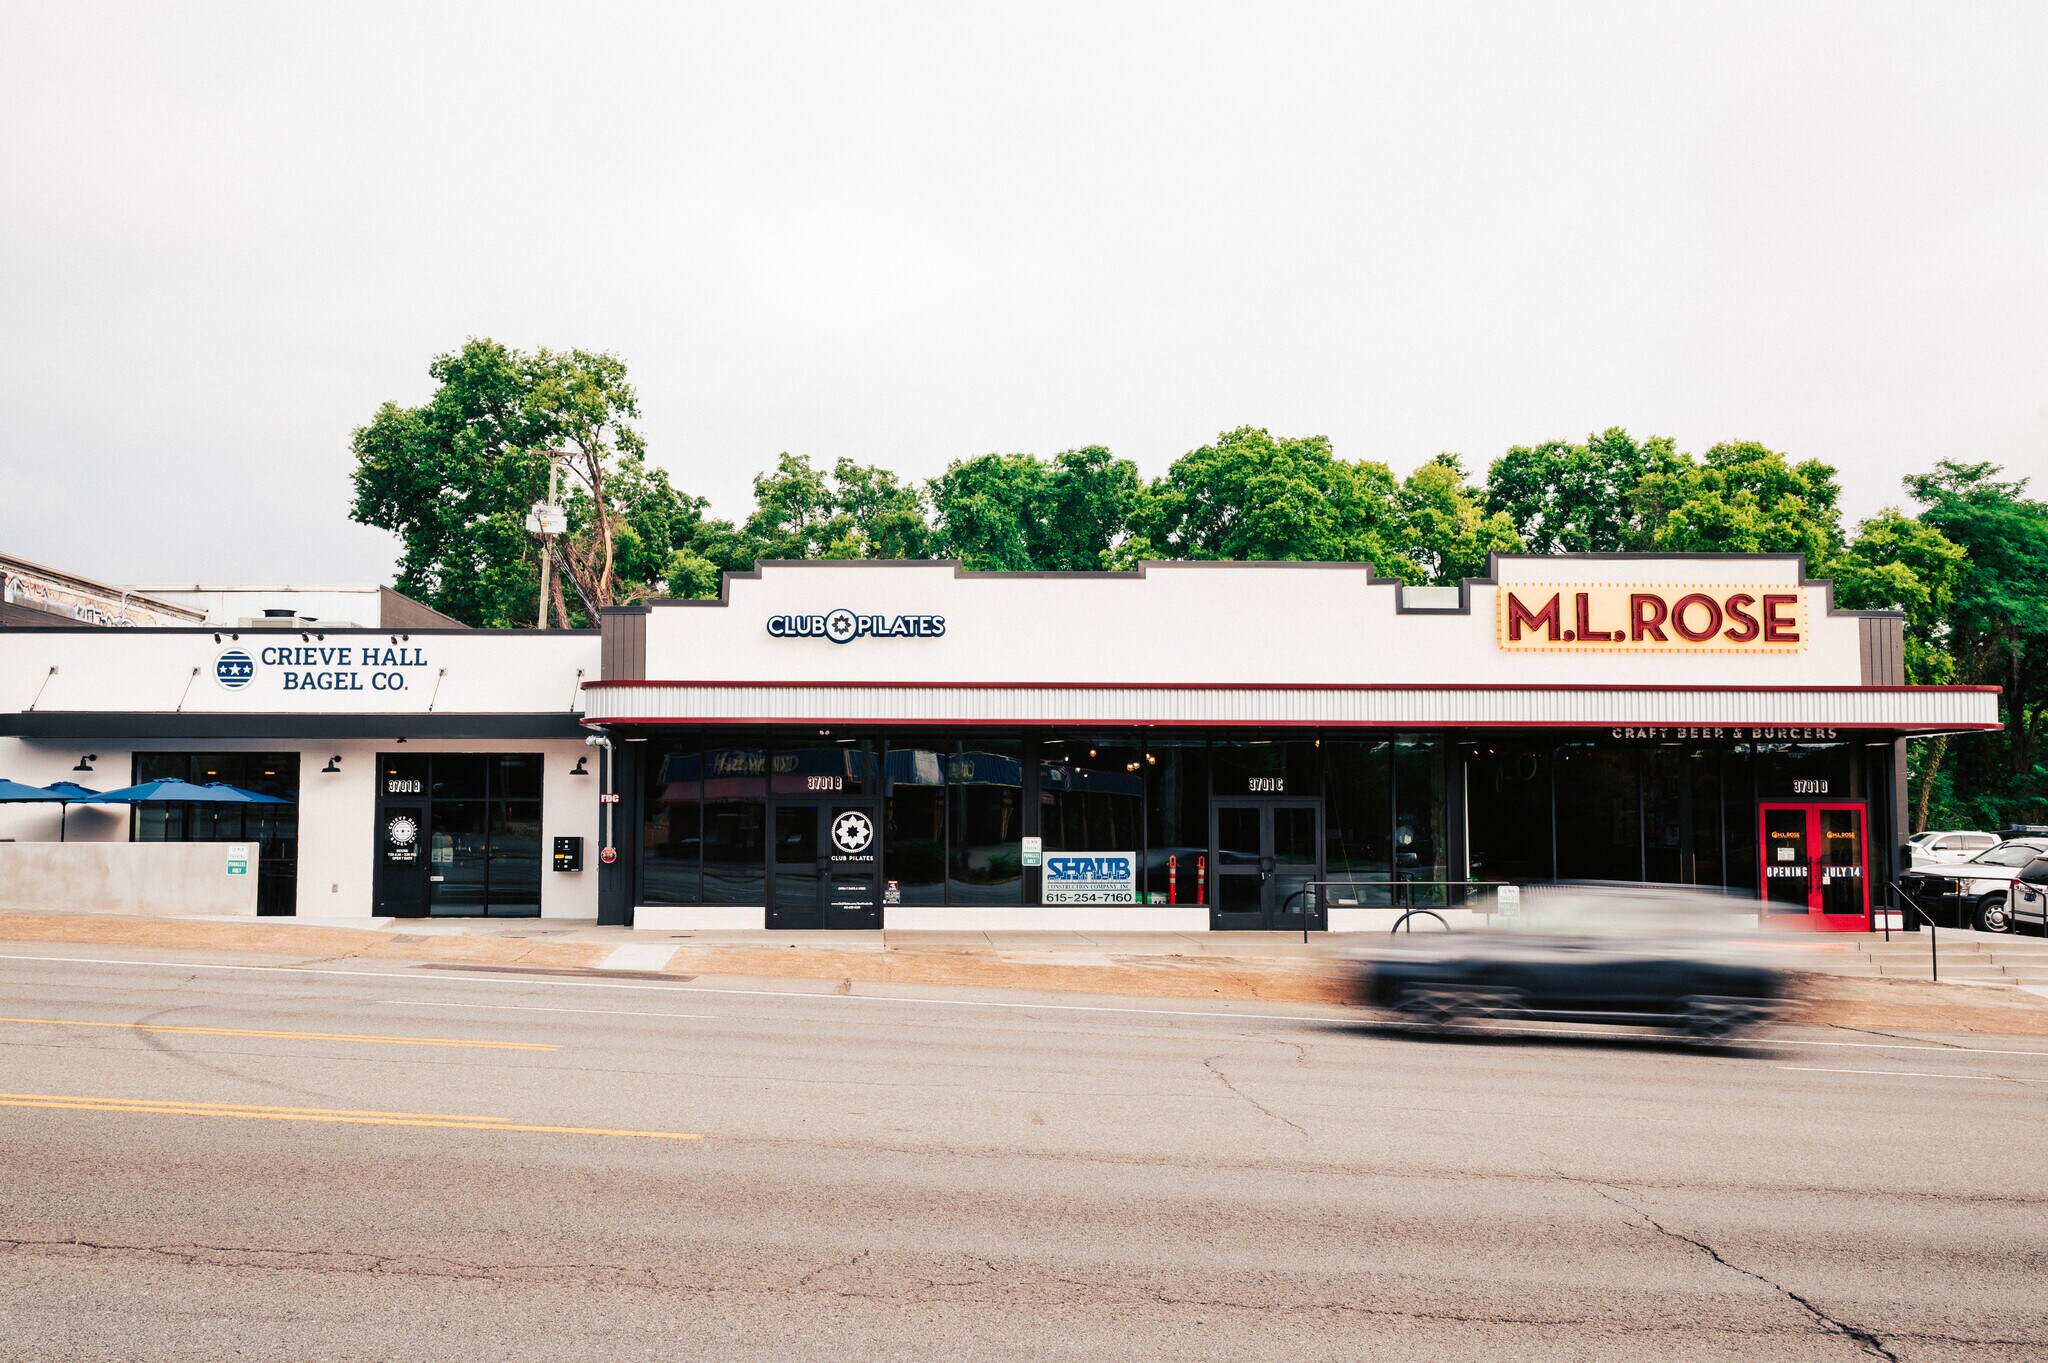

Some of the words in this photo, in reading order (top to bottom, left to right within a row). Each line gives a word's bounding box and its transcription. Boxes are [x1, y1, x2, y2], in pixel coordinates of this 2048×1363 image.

[768, 616, 826, 637] CLUB
[857, 616, 946, 637] PILATES
[261, 647, 351, 666] CRIEVE
[361, 648, 428, 666] HALL
[283, 672, 363, 690] BAGEL
[371, 673, 409, 690] CO.
[1612, 727, 1668, 739] CRAFT
[1677, 727, 1724, 739] BEER
[1732, 728, 1743, 739] &
[1752, 727, 1838, 739] BURGERS
[600, 794, 620, 803] FDC
[1047, 858, 1131, 880] SHAUB
[1766, 866, 1808, 877] OPENING
[1824, 866, 1847, 877] JULY
[1849, 866, 1860, 877] 14
[1046, 893, 1132, 902] 615-254-7160
